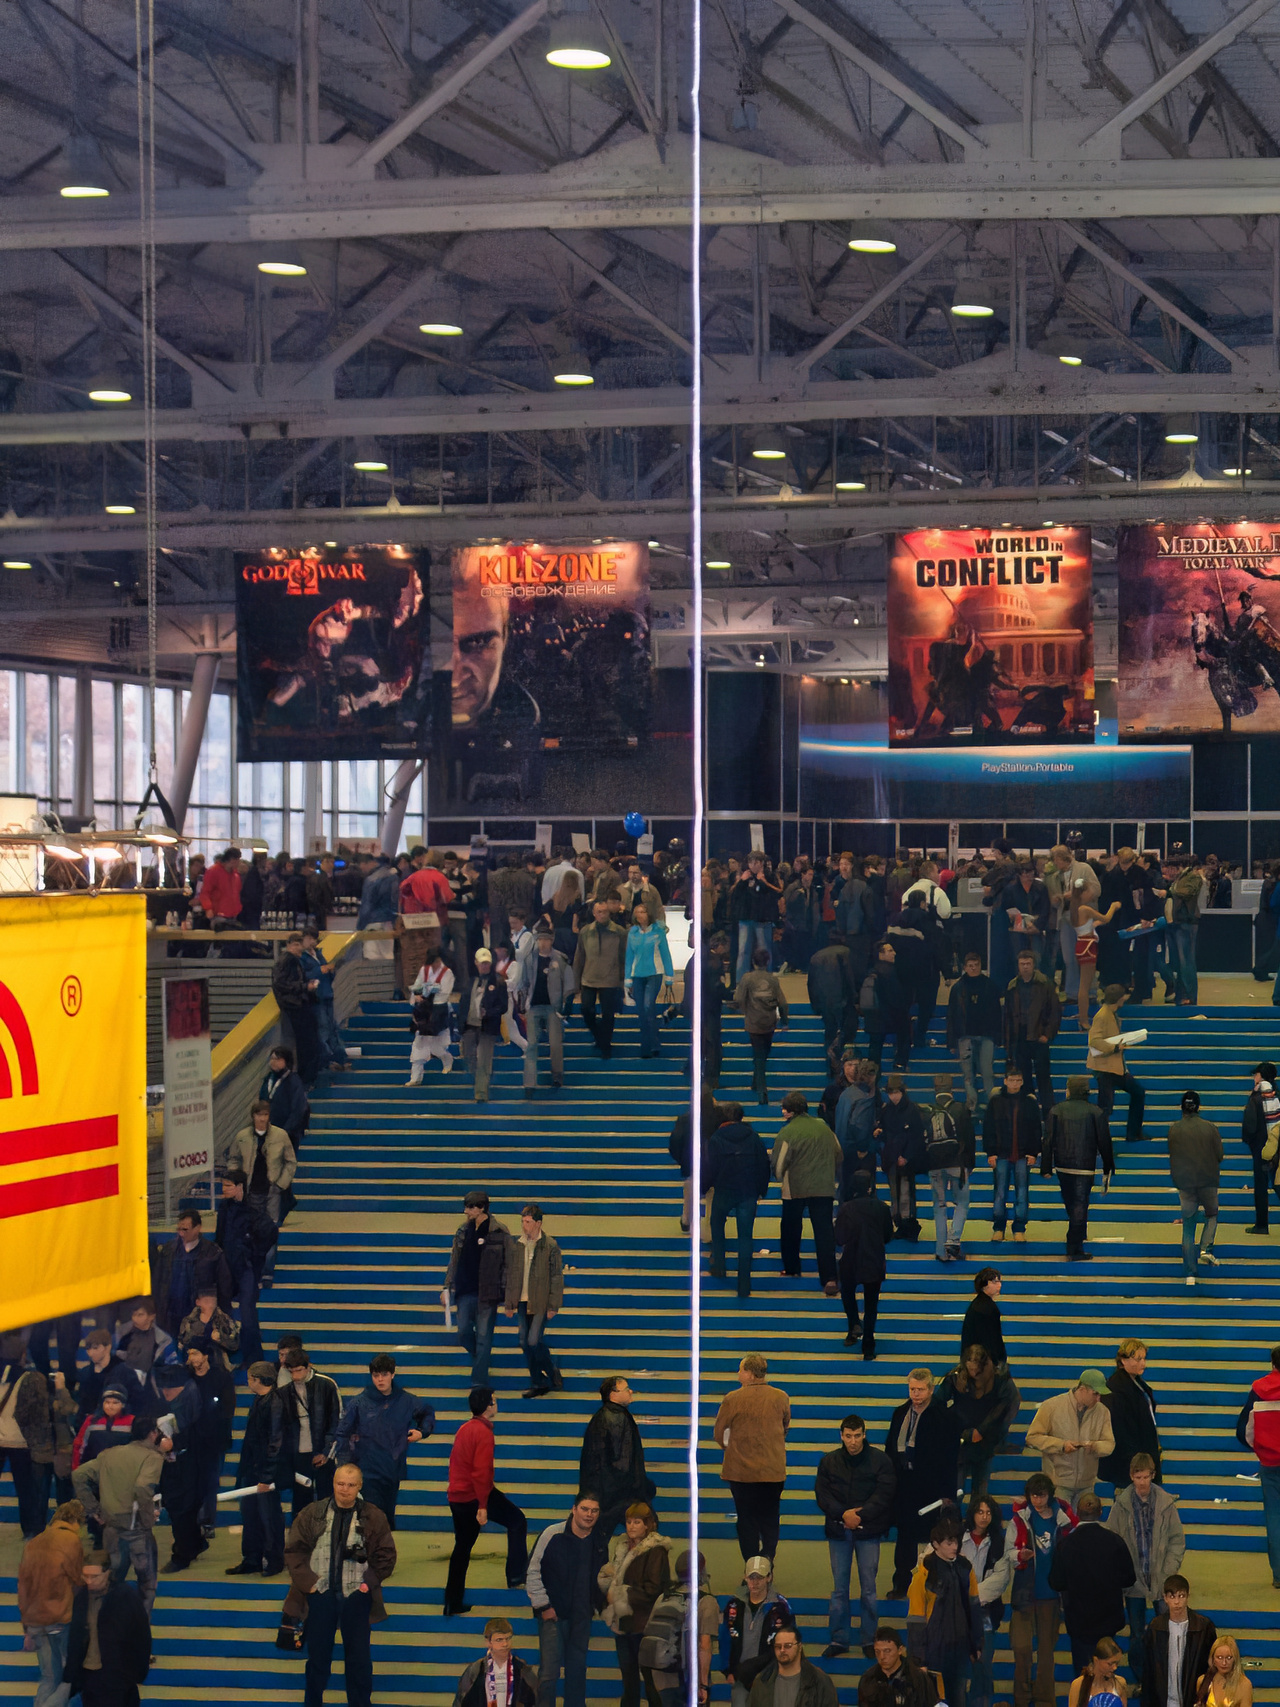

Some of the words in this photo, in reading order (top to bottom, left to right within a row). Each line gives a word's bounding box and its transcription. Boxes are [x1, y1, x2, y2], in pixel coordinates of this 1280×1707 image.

[975, 536, 1049, 554] WORLD
[1051, 543, 1063, 551] IN
[1157, 536, 1267, 555] MEDIEVAL
[479, 552, 617, 585] KILLZONE
[916, 555, 1064, 588] CONFLICT
[1183, 557, 1230, 569] TOTAL
[1232, 556, 1266, 569] WAR
[243, 565, 288, 583] GOD
[318, 562, 366, 582] WAR
[480, 584, 617, 598] ОСВОБОЖДЕНИЕ
